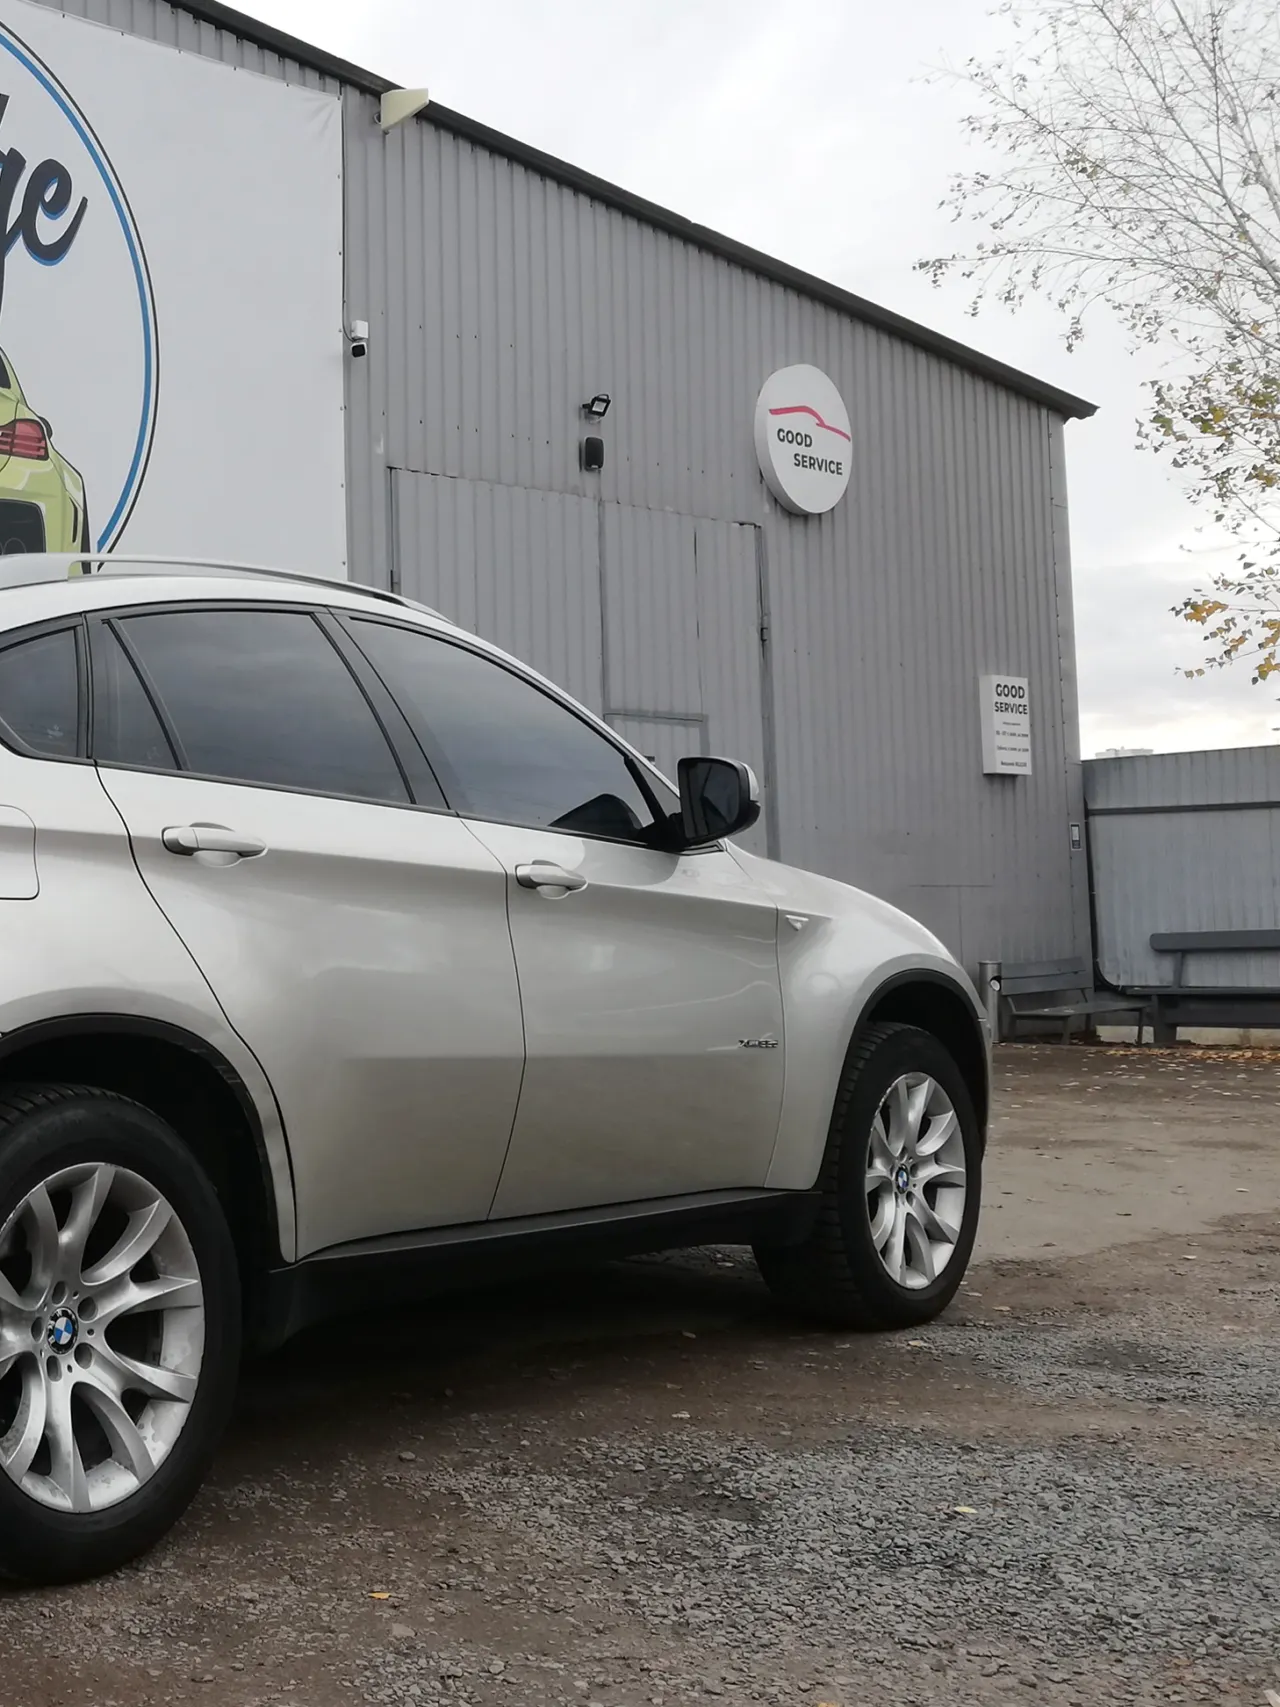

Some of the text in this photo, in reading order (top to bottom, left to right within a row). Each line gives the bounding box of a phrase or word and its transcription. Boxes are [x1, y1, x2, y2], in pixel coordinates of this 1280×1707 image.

[777, 428, 813, 448] GOOD
[793, 453, 843, 476] SERVICE
[995, 683, 1026, 699] GOOD
[994, 701, 1028, 715] SERVICE
